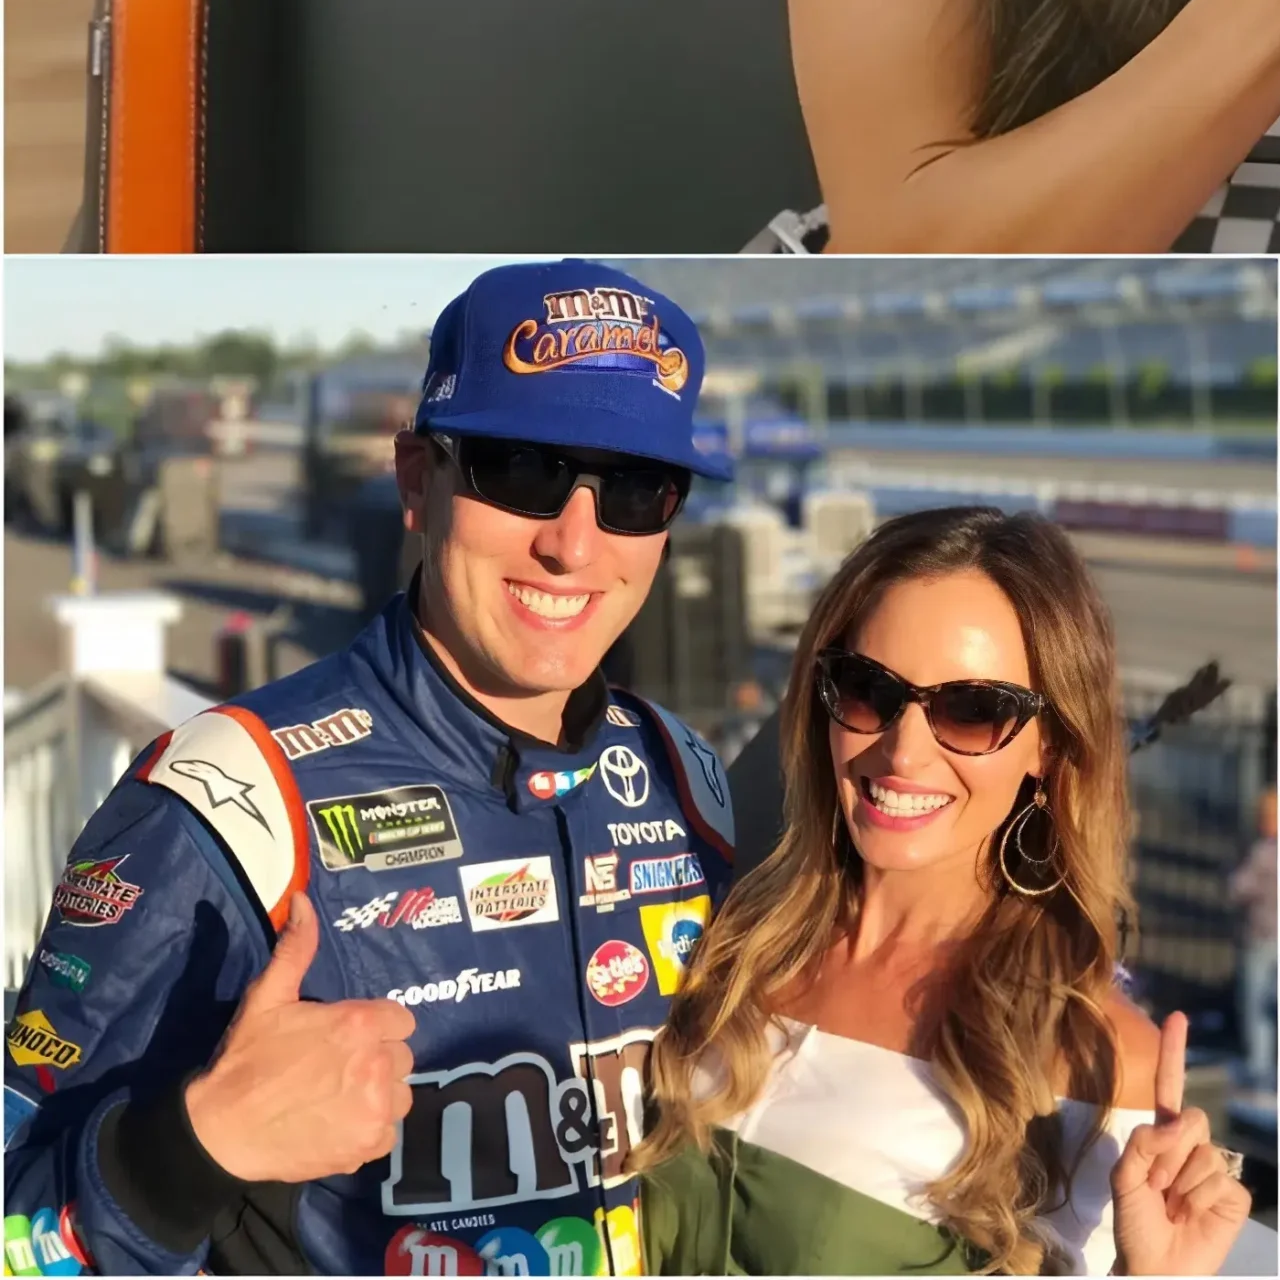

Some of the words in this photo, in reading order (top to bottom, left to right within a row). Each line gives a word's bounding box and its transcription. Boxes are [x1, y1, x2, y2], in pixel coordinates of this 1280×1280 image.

[503, 314, 664, 374] Caramel
[360, 797, 442, 822] MONSTER
[607, 819, 686, 847] TOYOTA
